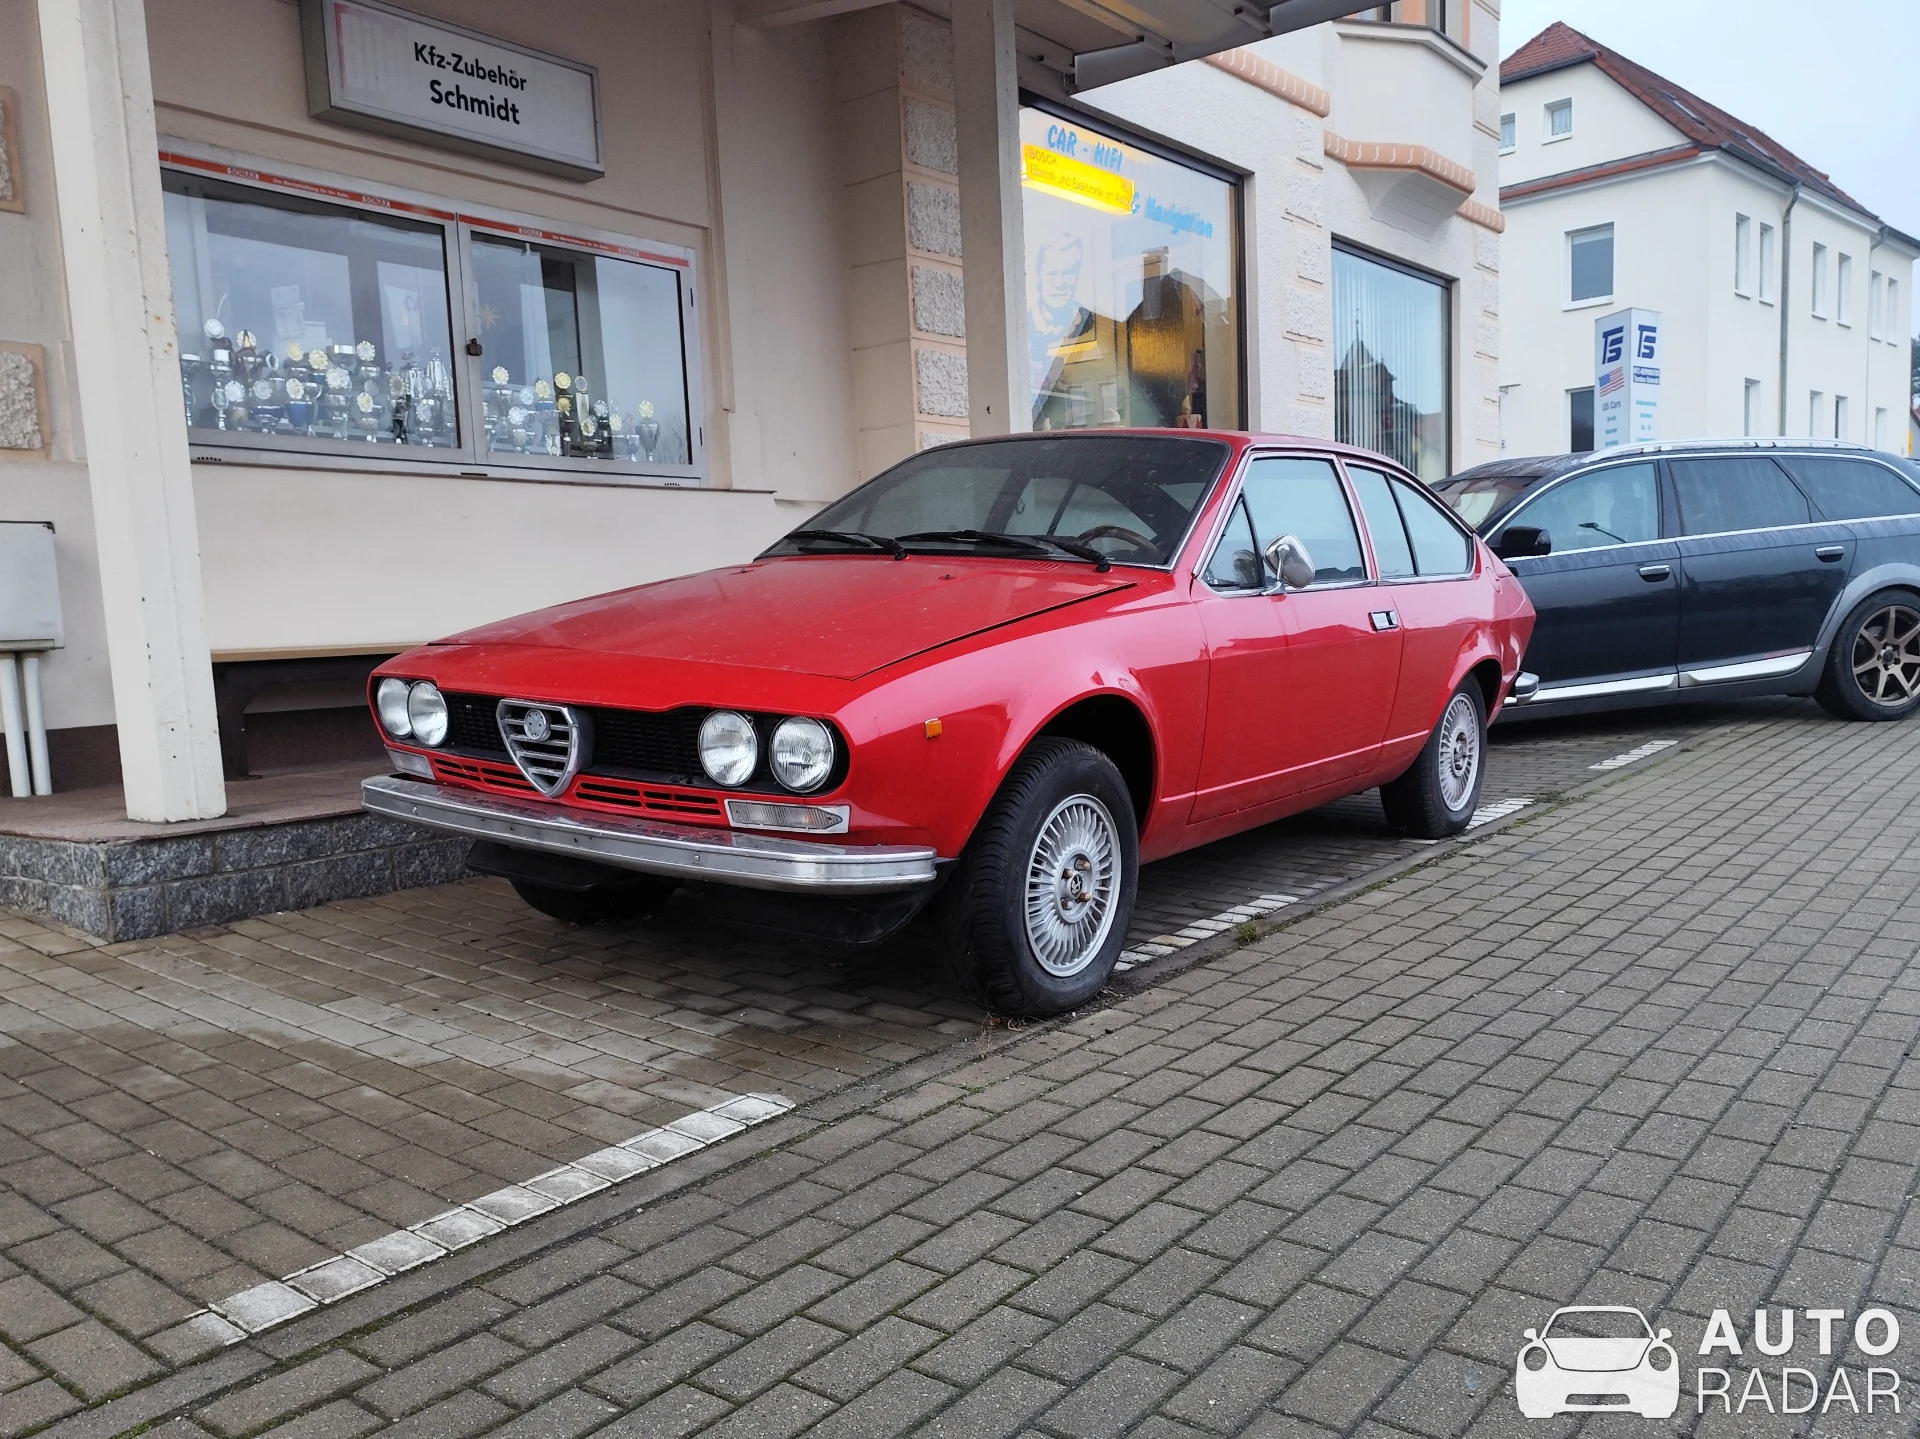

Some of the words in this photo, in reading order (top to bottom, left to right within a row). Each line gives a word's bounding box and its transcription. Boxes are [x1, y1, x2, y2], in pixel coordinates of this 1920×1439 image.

[414, 41, 528, 91] Kfz-Zubehör
[429, 79, 521, 125] Schmidt
[1047, 124, 1078, 157] CAR
[1094, 140, 1123, 173] HIFI
[1029, 148, 1058, 166] BOSCH
[229, 167, 258, 180] SONAX
[1058, 176, 1071, 188] und
[364, 196, 390, 208] SONAX
[1144, 195, 1213, 238] Navigation
[520, 228, 542, 238] SONAX
[619, 247, 640, 257] SONAX
[1602, 402, 1610, 411] US
[1610, 400, 1622, 410] Cars
